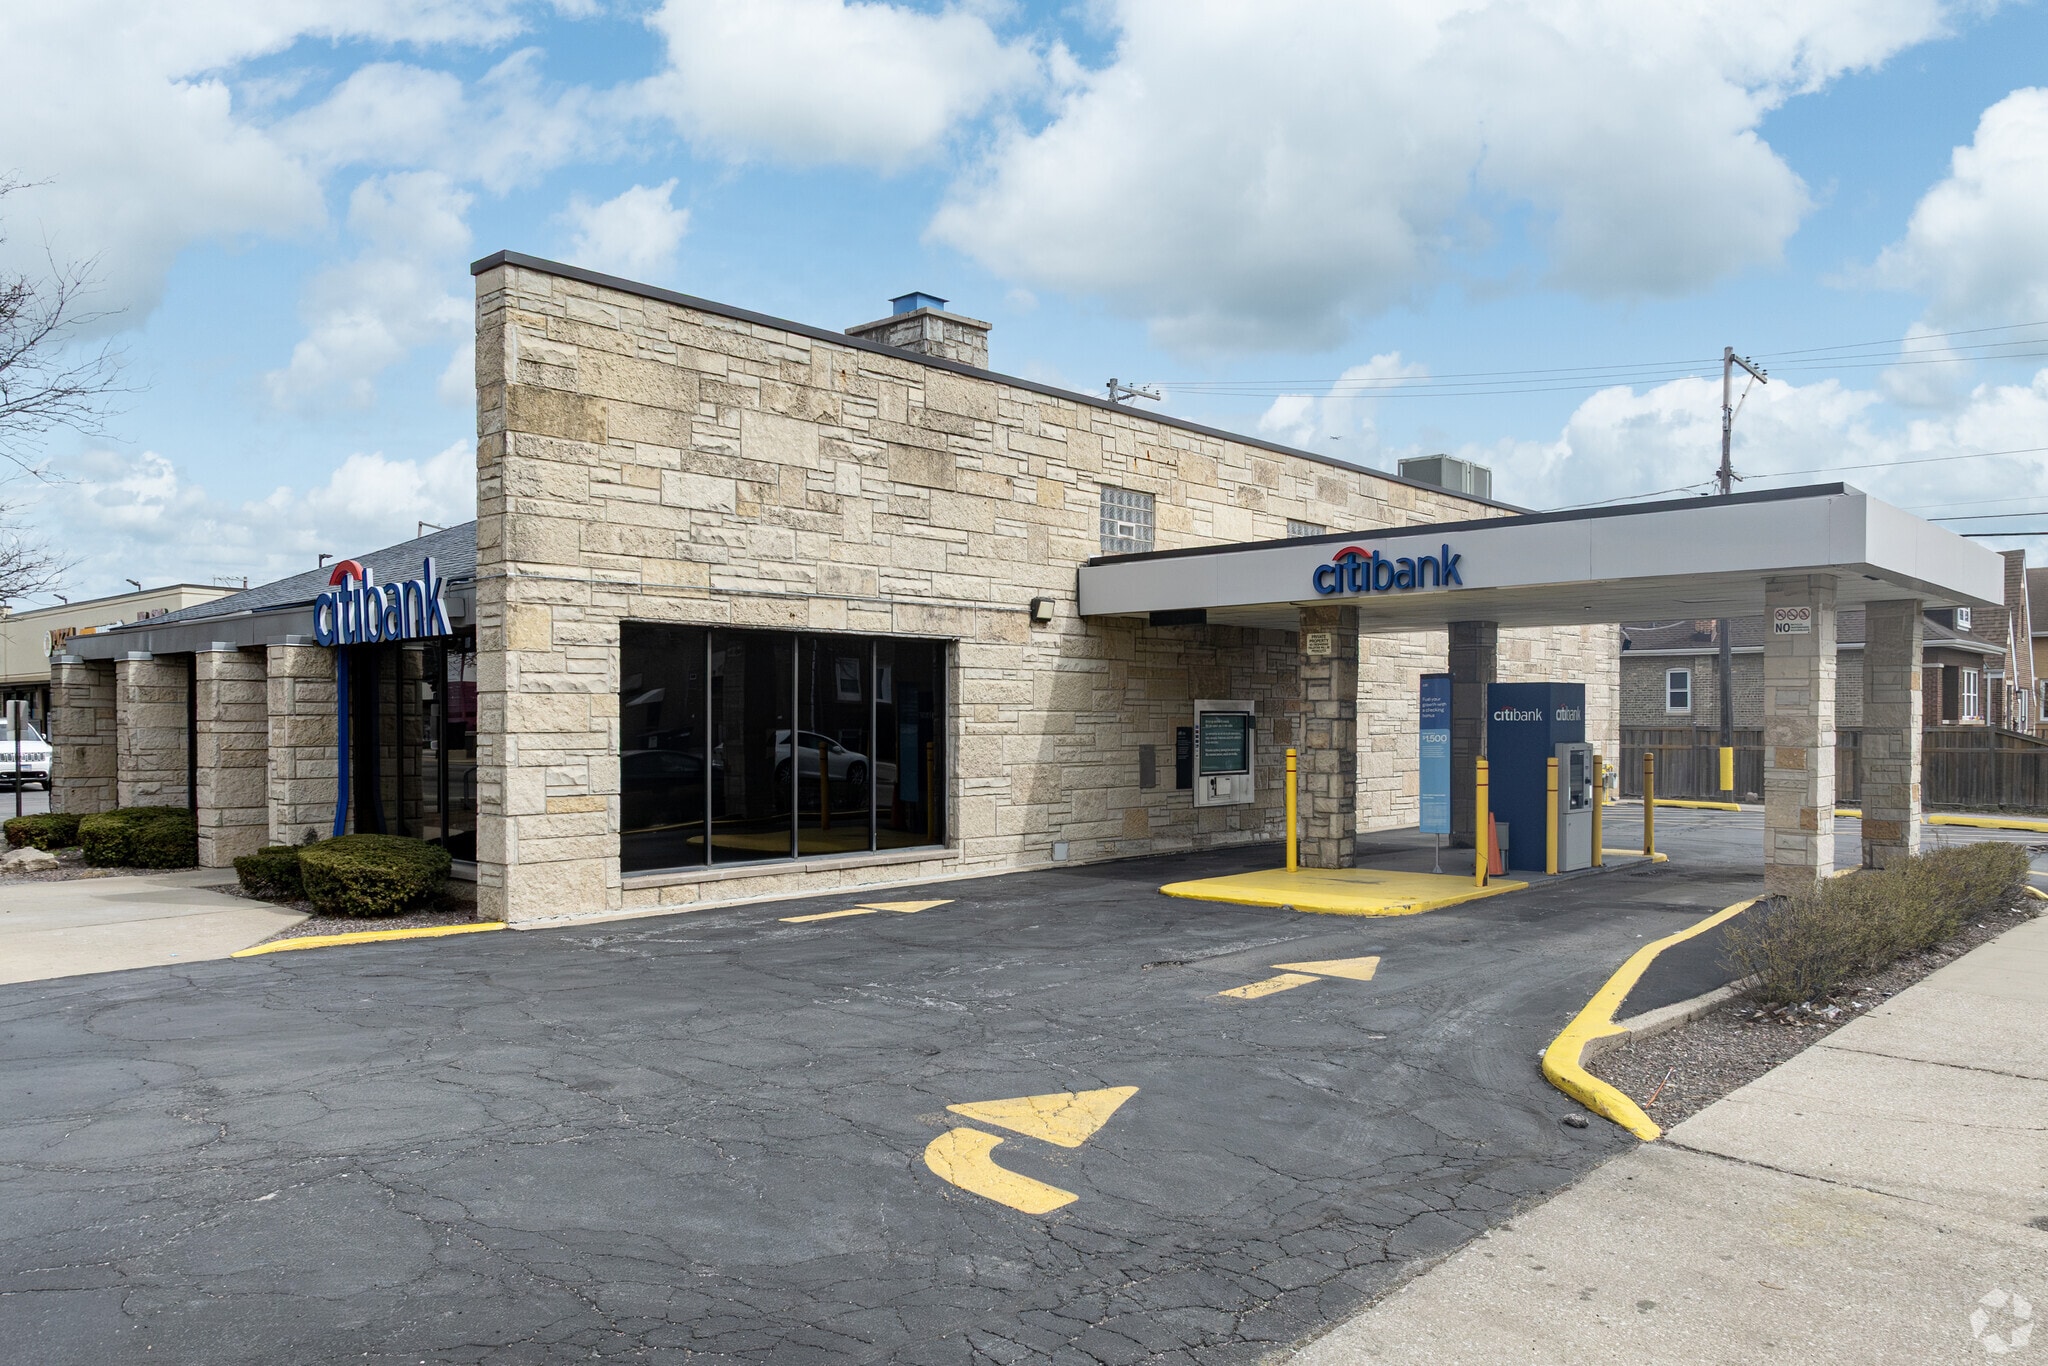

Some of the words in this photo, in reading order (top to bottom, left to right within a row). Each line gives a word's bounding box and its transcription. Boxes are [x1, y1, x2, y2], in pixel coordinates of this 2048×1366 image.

[1313, 543, 1463, 594] citibank
[313, 557, 453, 647] citibank
[1775, 623, 1790, 633] NO
[1493, 706, 1543, 721] citibank
